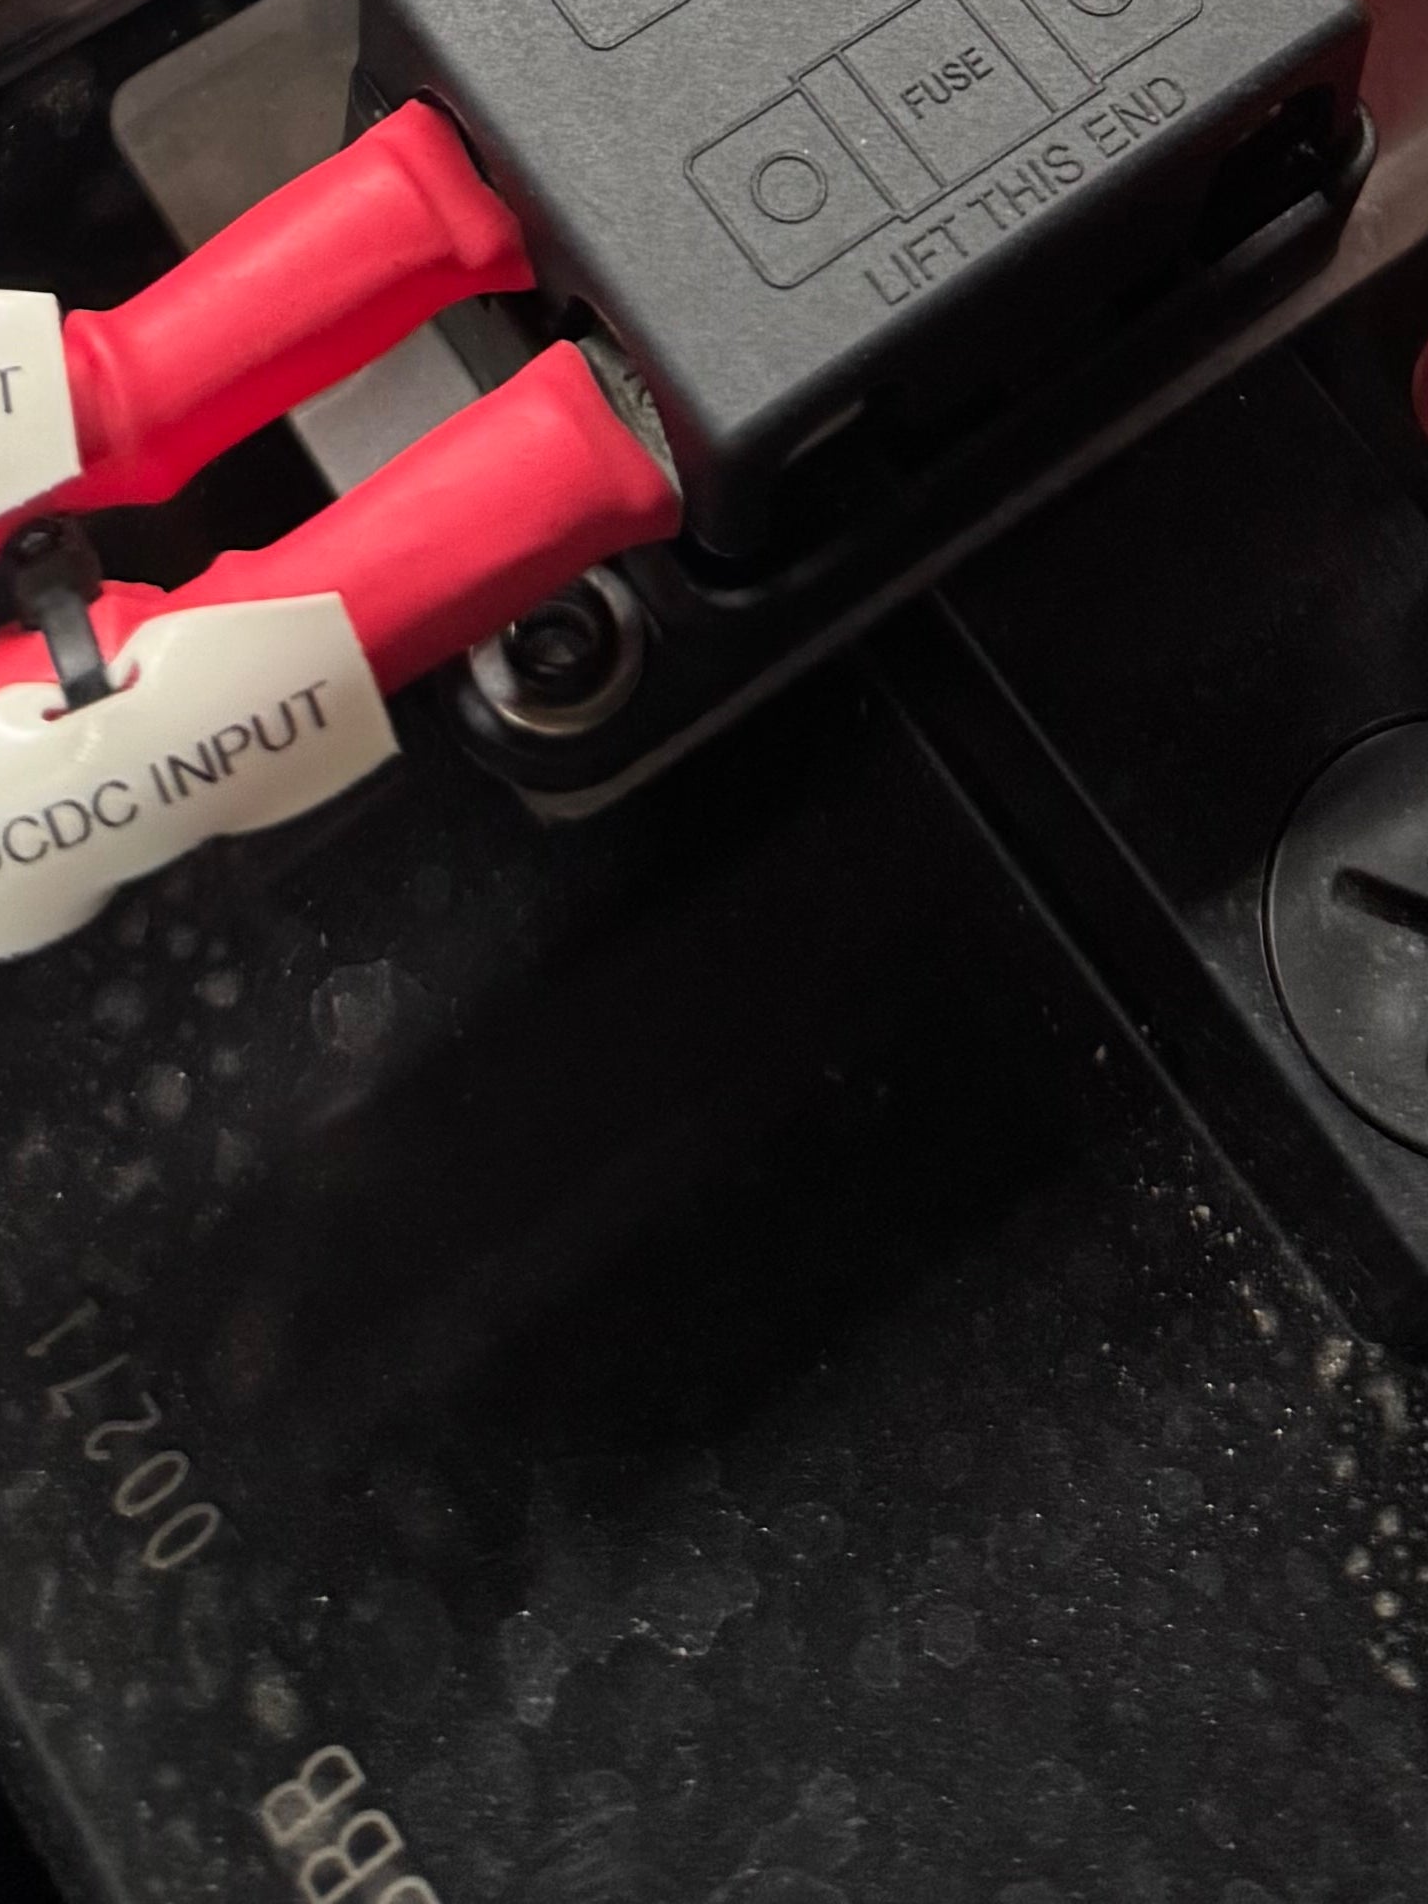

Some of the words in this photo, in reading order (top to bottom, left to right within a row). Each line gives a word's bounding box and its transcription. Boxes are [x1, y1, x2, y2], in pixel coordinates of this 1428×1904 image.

[898, 46, 995, 122] FUSE
[862, 216, 974, 307] LIFT
[966, 142, 1087, 234] THIS
[1081, 74, 1189, 160] END
[148, 680, 331, 805] INPUT
[26, 1301, 222, 1570] 00271
